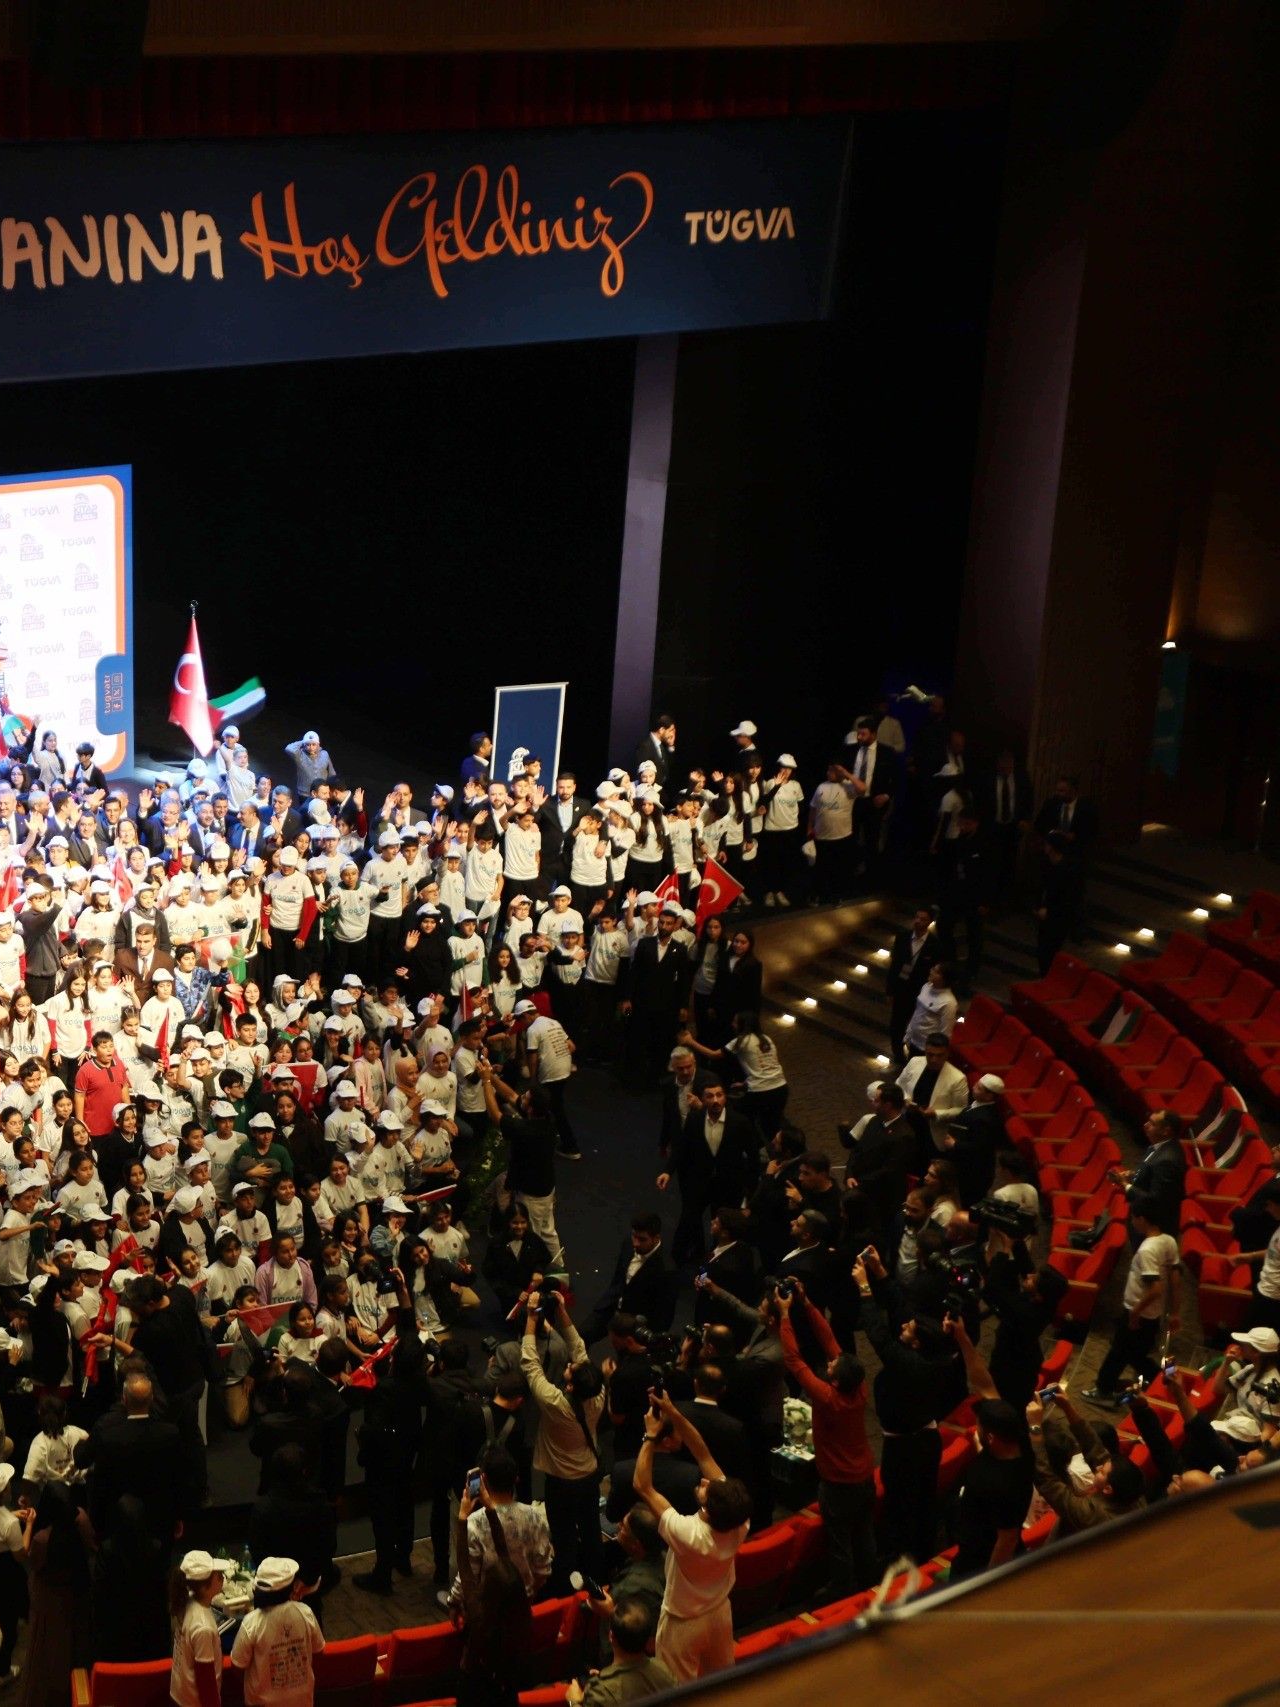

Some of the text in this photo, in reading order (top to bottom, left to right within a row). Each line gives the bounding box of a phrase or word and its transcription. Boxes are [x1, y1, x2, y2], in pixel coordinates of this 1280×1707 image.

[239, 181, 371, 289] Hoş
[374, 163, 655, 298] Geldiniz
[684, 205, 798, 246] TÜGVA
